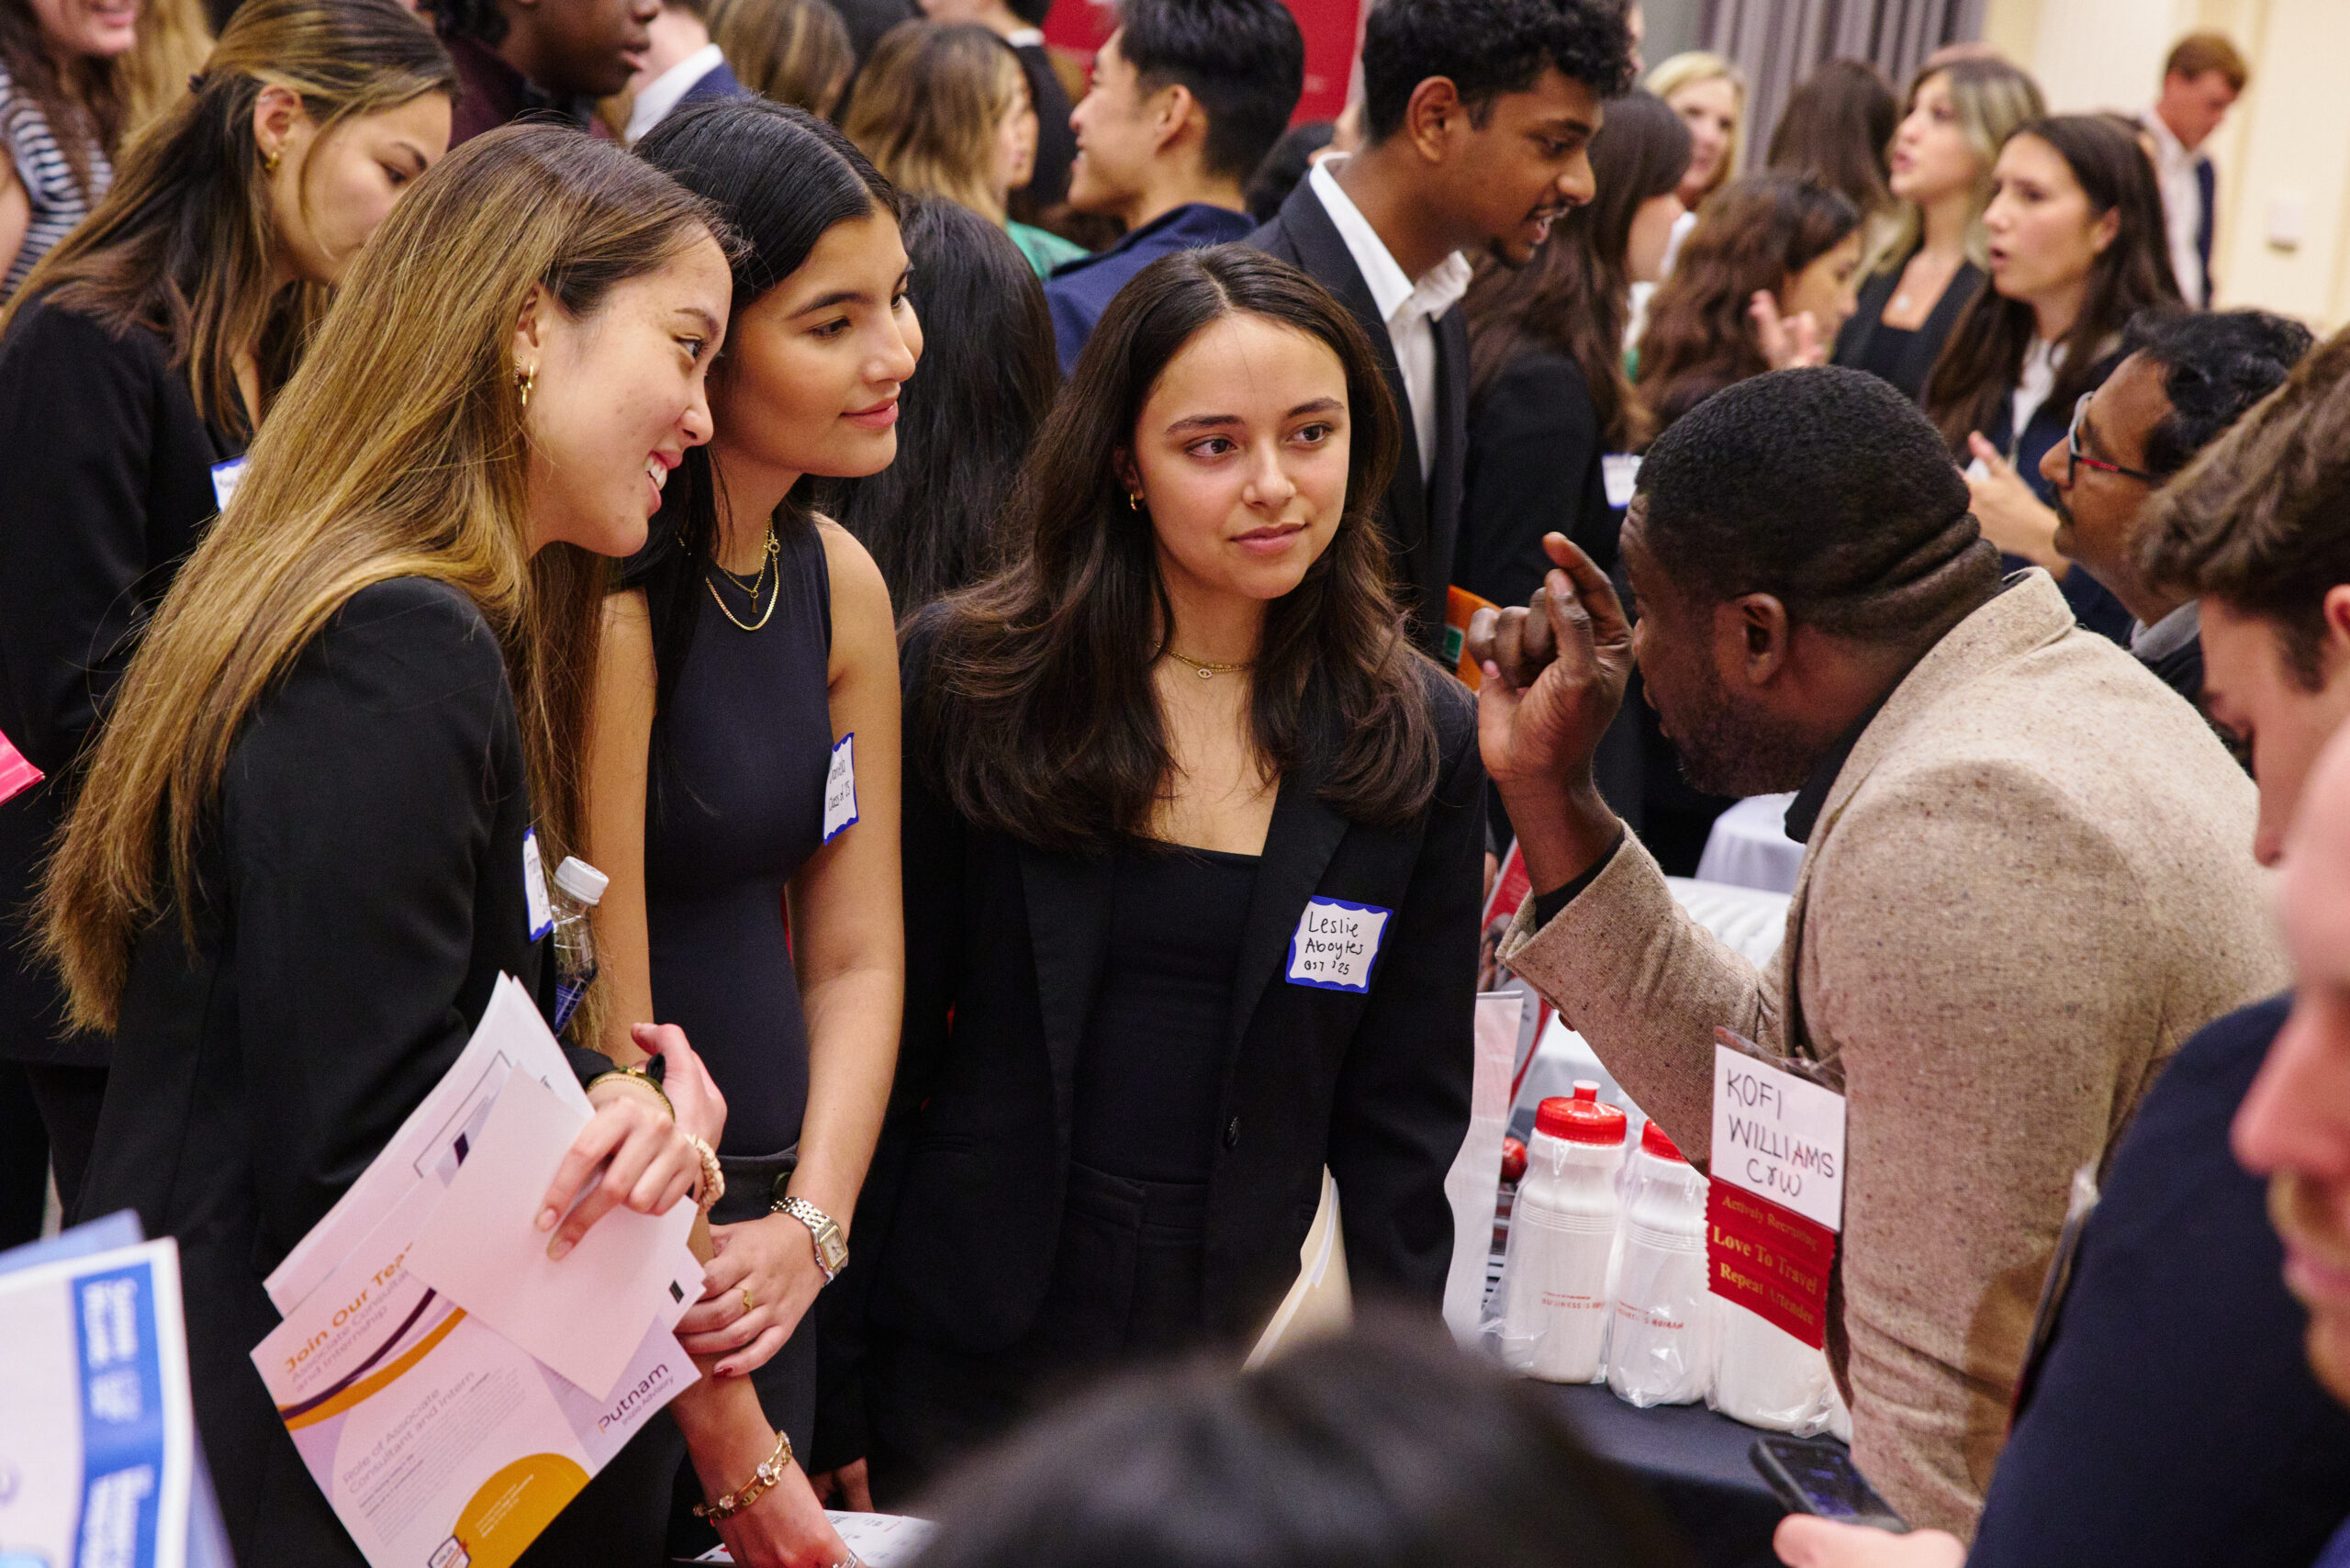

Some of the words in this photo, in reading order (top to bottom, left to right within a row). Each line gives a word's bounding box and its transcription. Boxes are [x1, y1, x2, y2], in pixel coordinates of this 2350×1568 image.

[1304, 937, 1364, 960] Aboytes
[1308, 911, 1359, 938] Leslie
[1727, 1069, 1784, 1120] KOFI
[1729, 1114, 1835, 1179] WILLIAMS
[1721, 1194, 1764, 1225] Actively
[1767, 1213, 1818, 1251] Recruiting
[1713, 1225, 1751, 1257] Love
[1754, 1243, 1774, 1267] To
[1776, 1254, 1818, 1295] Travel
[285, 1330, 329, 1374] Join
[331, 1289, 368, 1328] Our
[370, 1242, 413, 1287] Tea
[1719, 1261, 1763, 1295] Repeat
[1769, 1287, 1815, 1326] Attendee
[597, 1362, 669, 1434] Putnam
